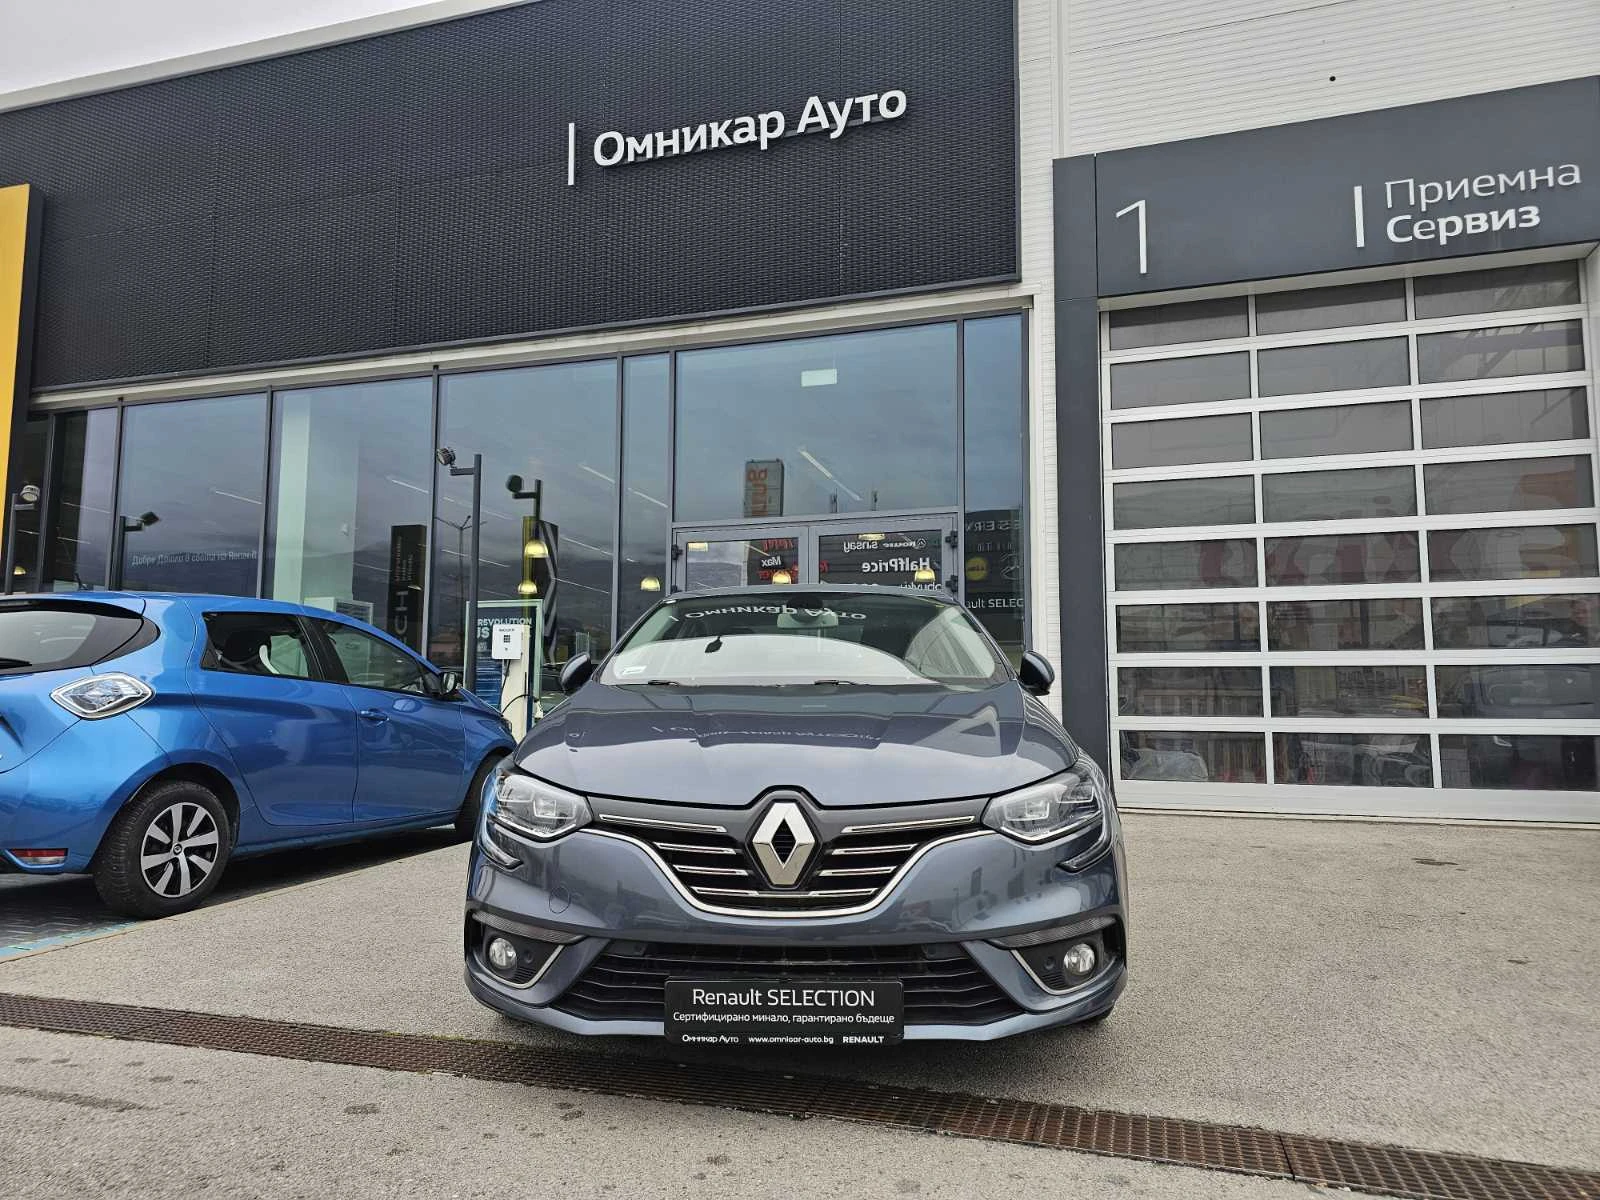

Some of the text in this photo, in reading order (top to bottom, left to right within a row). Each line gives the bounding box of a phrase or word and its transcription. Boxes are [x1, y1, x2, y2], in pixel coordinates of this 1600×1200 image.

[593, 89, 907, 167] Омникар Ауто
[1384, 163, 1582, 212] Приемна
[1115, 199, 1147, 275] 1
[1385, 205, 1542, 246] Сервиз
[477, 617, 532, 626] REVOLUTION
[692, 988, 875, 1007] Renault SELECTION
[673, 1012, 895, 1025] Сертифицирано минало, гарантирано бъдеще
[842, 1035, 884, 1044] RENAULT
